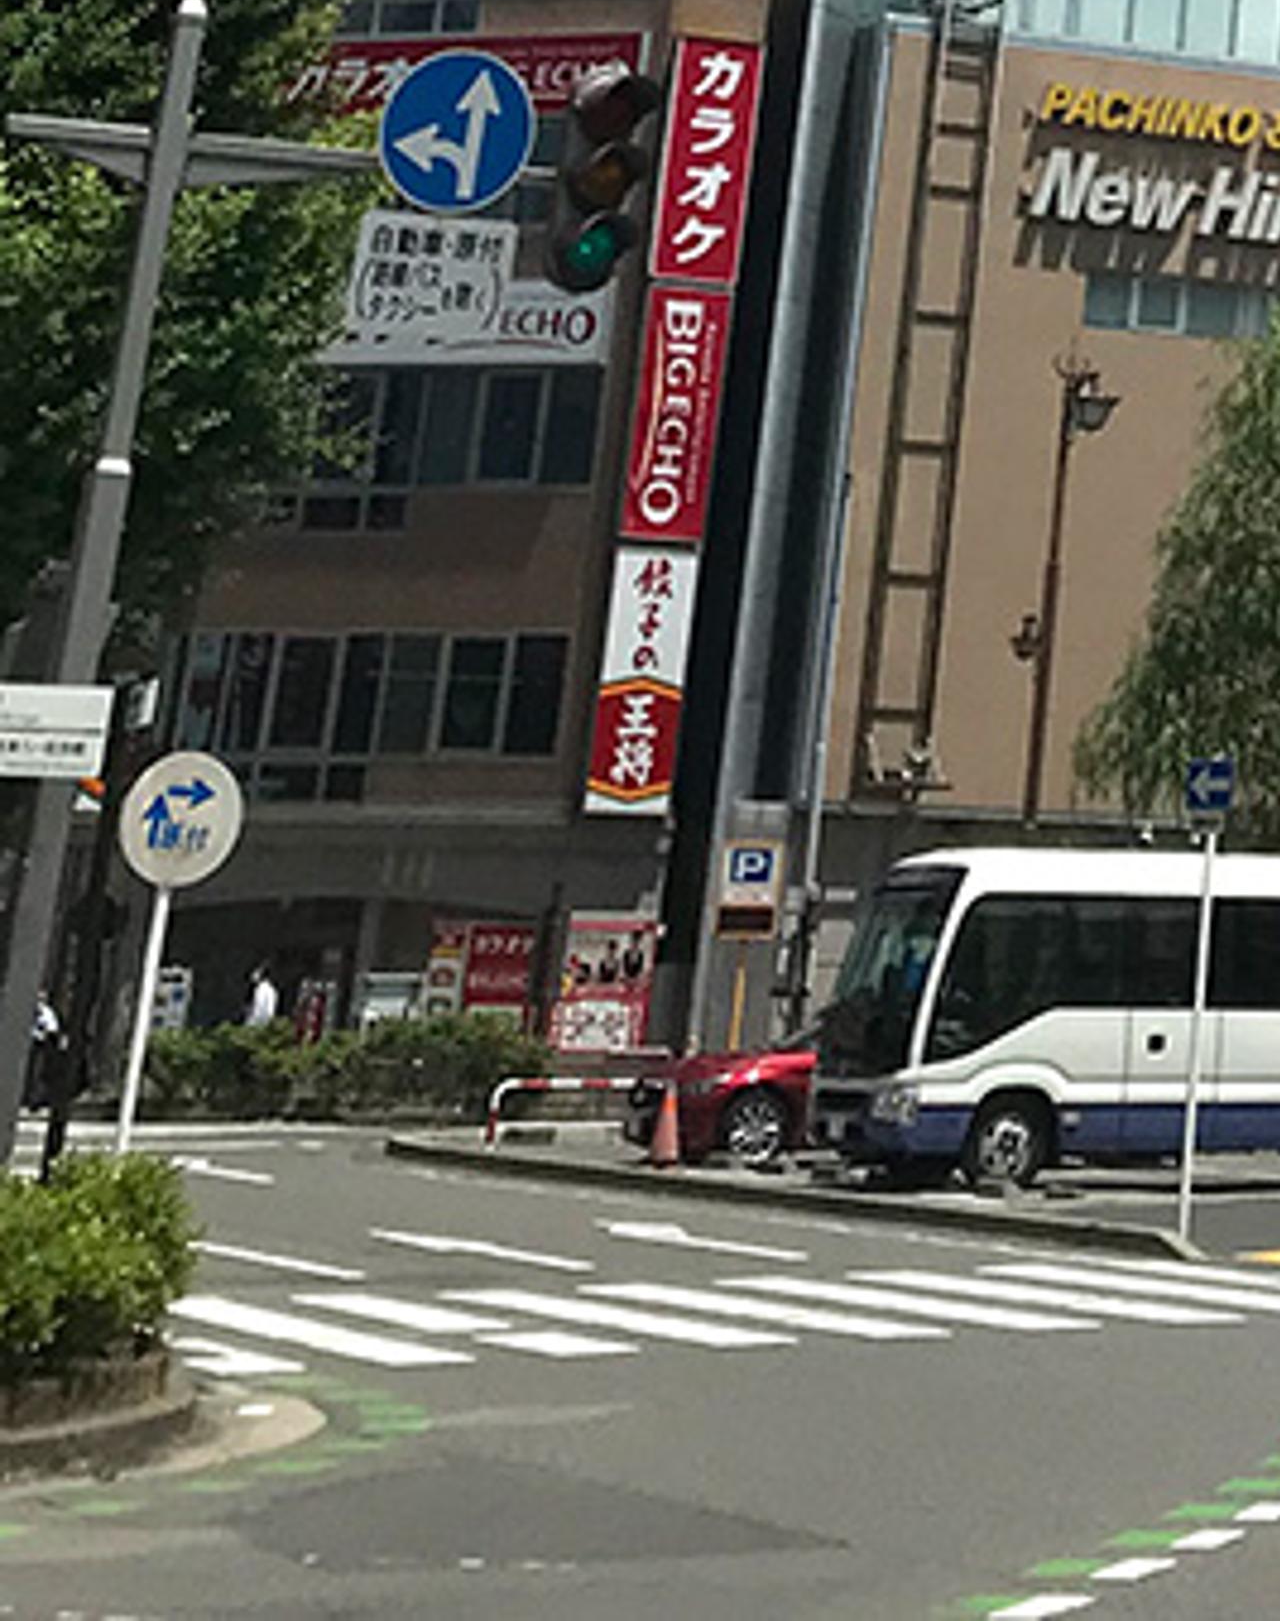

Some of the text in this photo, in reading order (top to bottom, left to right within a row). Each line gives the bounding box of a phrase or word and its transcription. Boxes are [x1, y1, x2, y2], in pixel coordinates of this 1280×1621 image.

[670, 50, 745, 264] カラオケ
[1042, 82, 1262, 147] PACHINKO
[1030, 147, 1198, 234] New
[500, 306, 597, 346] ECHO
[665, 299, 705, 388] BIG
[639, 395, 693, 526] ECHO
[609, 556, 675, 787] 餃子の王将
[734, 851, 765, 879] P
